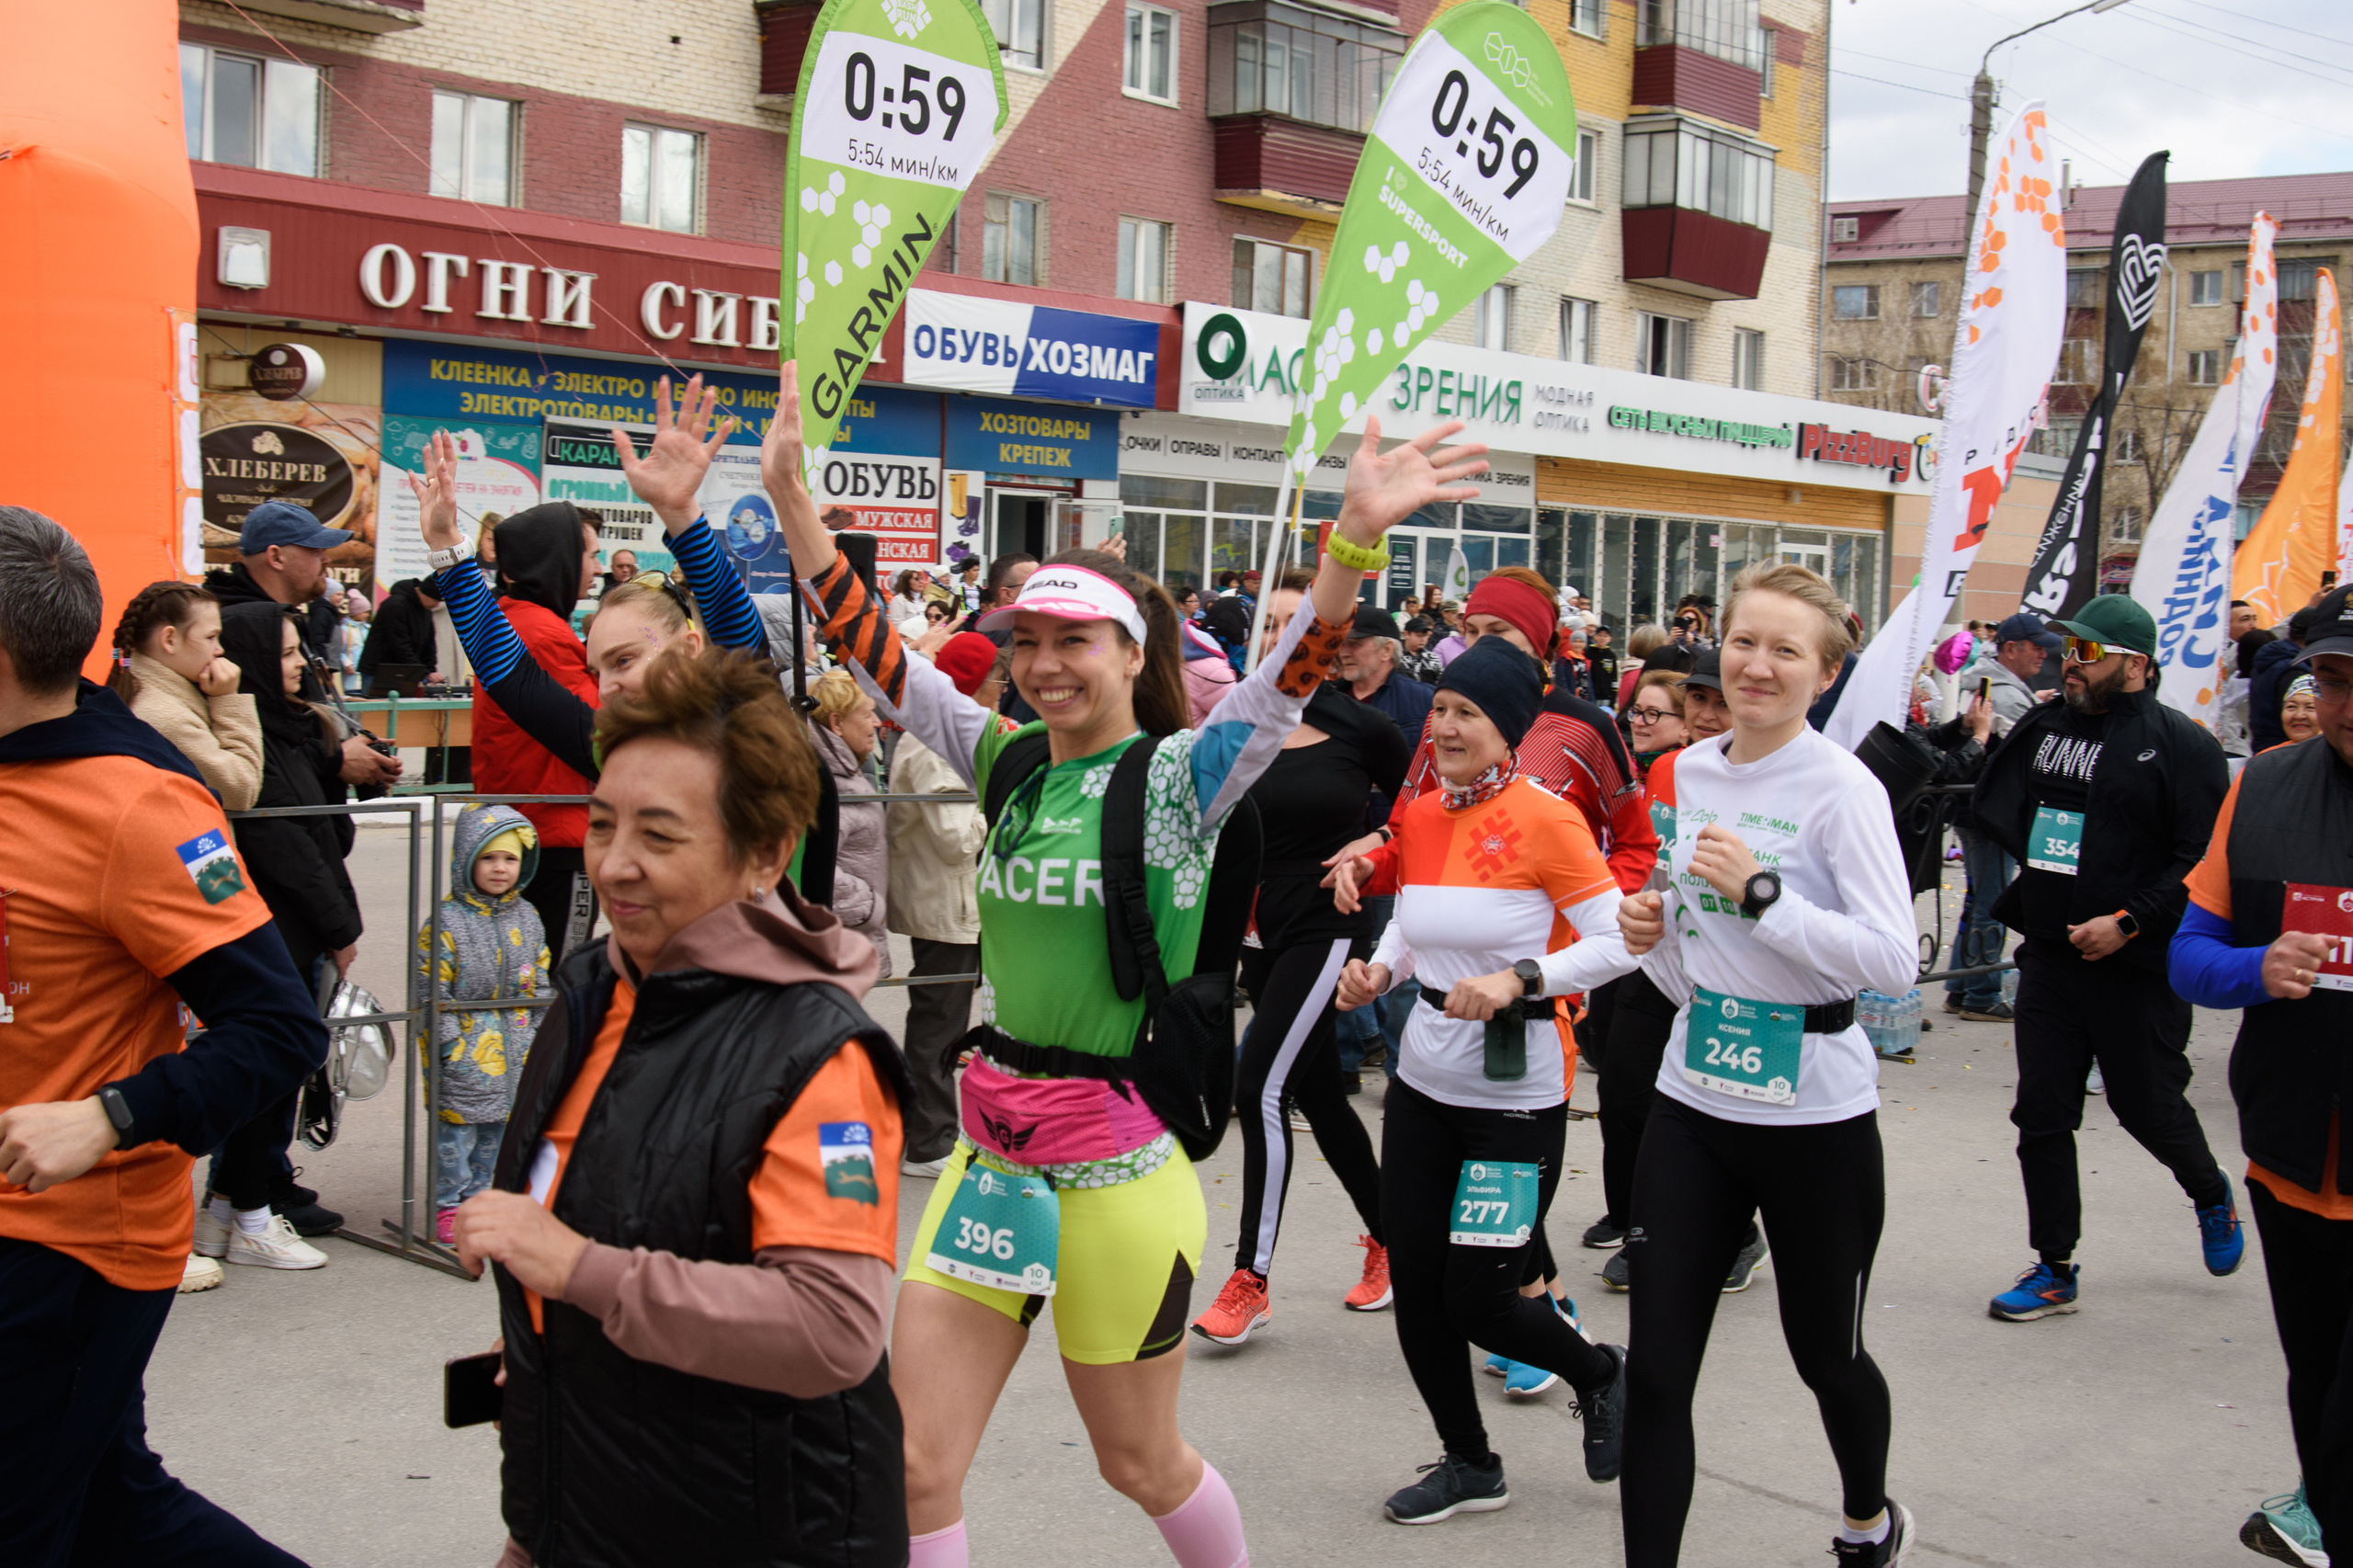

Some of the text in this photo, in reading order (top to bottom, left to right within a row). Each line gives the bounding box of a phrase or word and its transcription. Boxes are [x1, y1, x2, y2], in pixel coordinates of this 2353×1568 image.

[896, 8, 917, 24] RUN
[845, 51, 966, 142] 0:59
[1432, 70, 1539, 200] 0:59
[847, 138, 884, 169] 5:54
[1417, 147, 1451, 190] 5:54
[1379, 185, 1469, 269] SUPERSPORT
[359, 243, 781, 351] ОГНИ СИБ
[812, 211, 933, 419] GARMIN
[914, 324, 1154, 384] ОБУВЬ ХОЗМАГ
[430, 358, 532, 388] КЛЕЁНКА
[552, 371, 645, 399] ЭЛЕКТРО
[1195, 388, 1245, 400] ОПТИКА
[1391, 362, 1522, 424] ЗРЕНИЯ
[1533, 384, 1594, 406] МОДНАЯ
[460, 392, 643, 424] ЭЛЕКТРОТОВАРЫ
[1608, 404, 1647, 431] СЕТЬ
[980, 412, 1091, 441] ХОЗТОВАРЫ
[1533, 410, 1590, 434] ОПТИКА
[999, 443, 1072, 468] КРЕПЕЖ
[1127, 435, 1161, 451] ОЧКИ
[1170, 440, 1221, 458] ОПРАВЫ
[1798, 423, 1913, 483] PizzBurg
[205, 457, 327, 483] ХЛЕБЕРЕВ
[1315, 456, 1347, 470] ИНЗЫ
[824, 460, 937, 500] ОБУВЬ
[1495, 472, 1530, 487] ЗРЕНИЯ
[856, 509, 934, 529] МУЖСКАЯ
[877, 541, 930, 559] НСКАЯ
[1023, 579, 1078, 594] HEAD
[2044, 837, 2081, 859] 354
[1718, 1023, 1751, 1037] КСЕНИЯ
[1705, 1038, 1763, 1074] 246
[1774, 1081, 1786, 1090] 10
[1503, 1112, 1537, 1120] NORDSKI
[1466, 1186, 1502, 1194] ЭЛЬВИРА
[1460, 1199, 1510, 1225] 277
[954, 1216, 1016, 1260] 396
[1519, 1228, 1528, 1236] 10
[1030, 1268, 1044, 1278] 10
